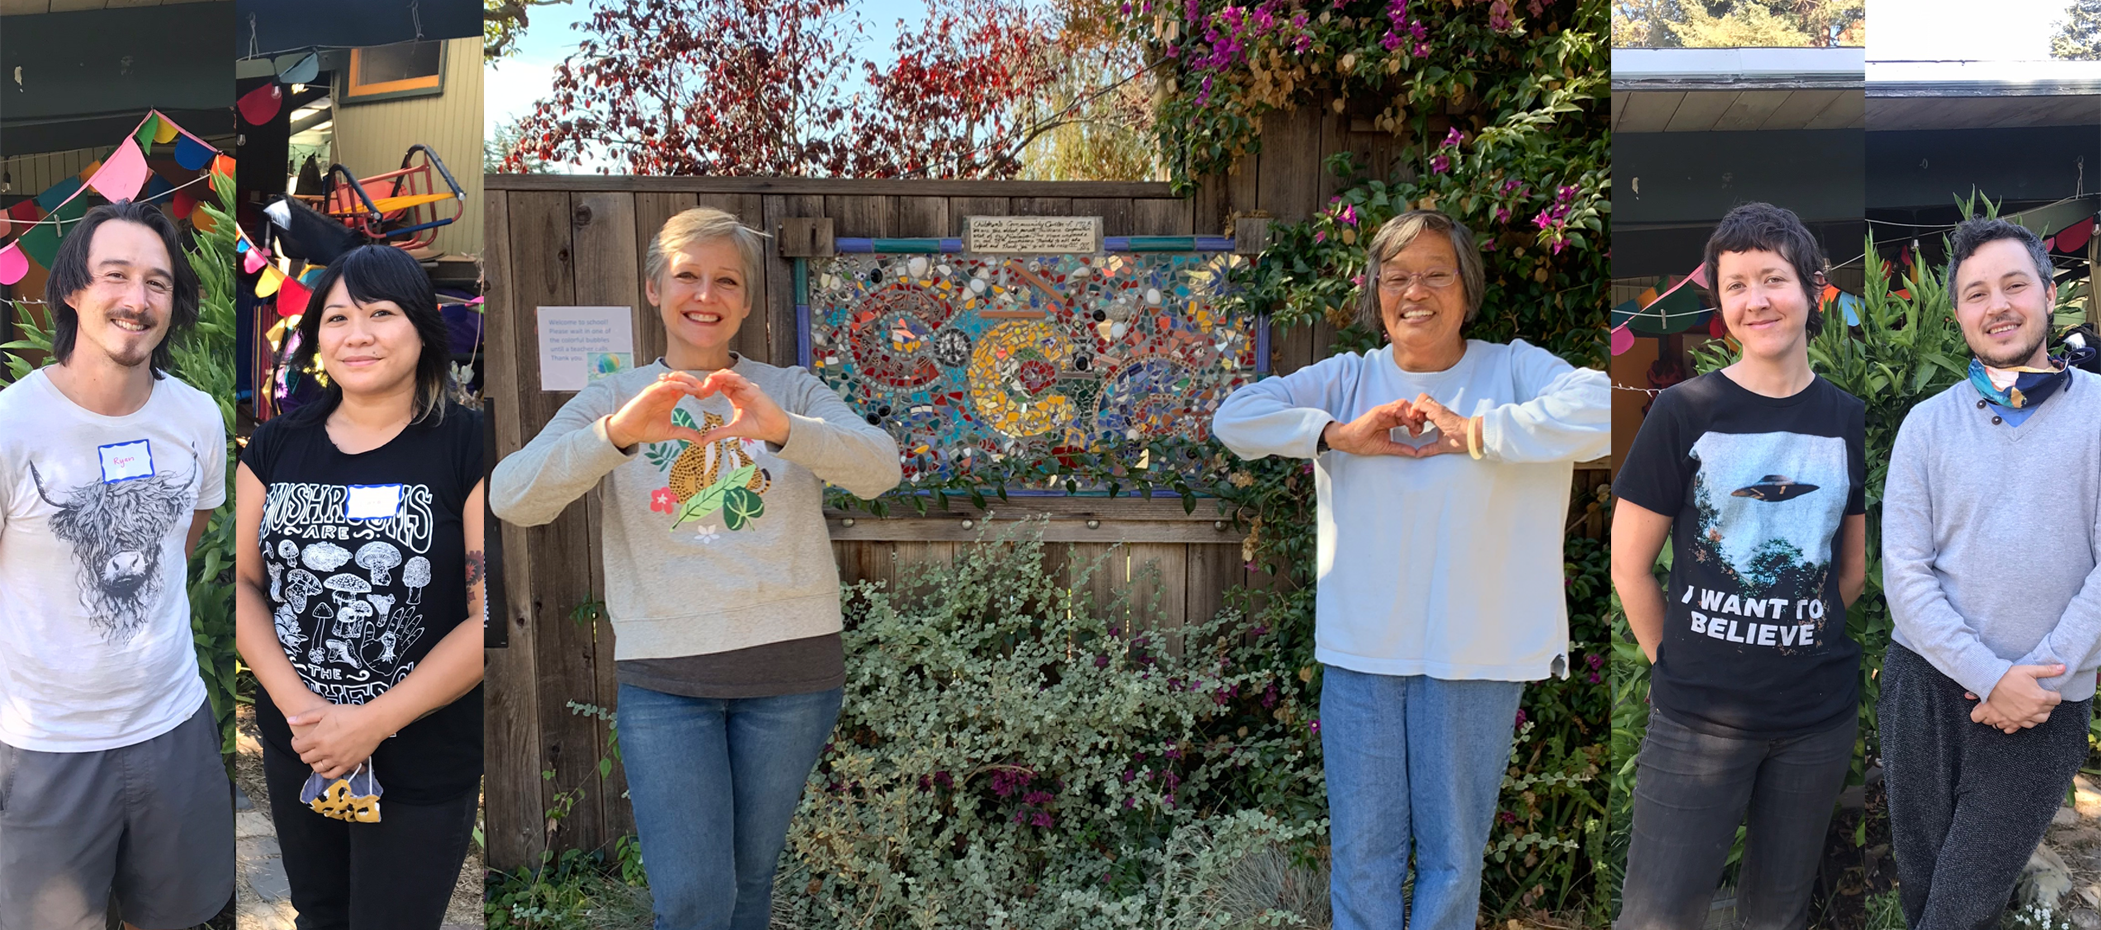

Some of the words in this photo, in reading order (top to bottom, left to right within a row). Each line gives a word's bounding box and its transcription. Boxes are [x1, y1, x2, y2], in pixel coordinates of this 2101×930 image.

[1006, 220, 1044, 229] Community
[968, 315, 1074, 439] C
[113, 456, 135, 468] Ryan
[258, 482, 434, 554] MUSHRMS
[302, 525, 350, 540] ARE
[1681, 585, 1694, 605] I
[1700, 588, 1789, 620] WANT
[1795, 598, 1824, 620] TO
[1690, 611, 1815, 647] BELIEVE
[307, 663, 342, 680] THE
